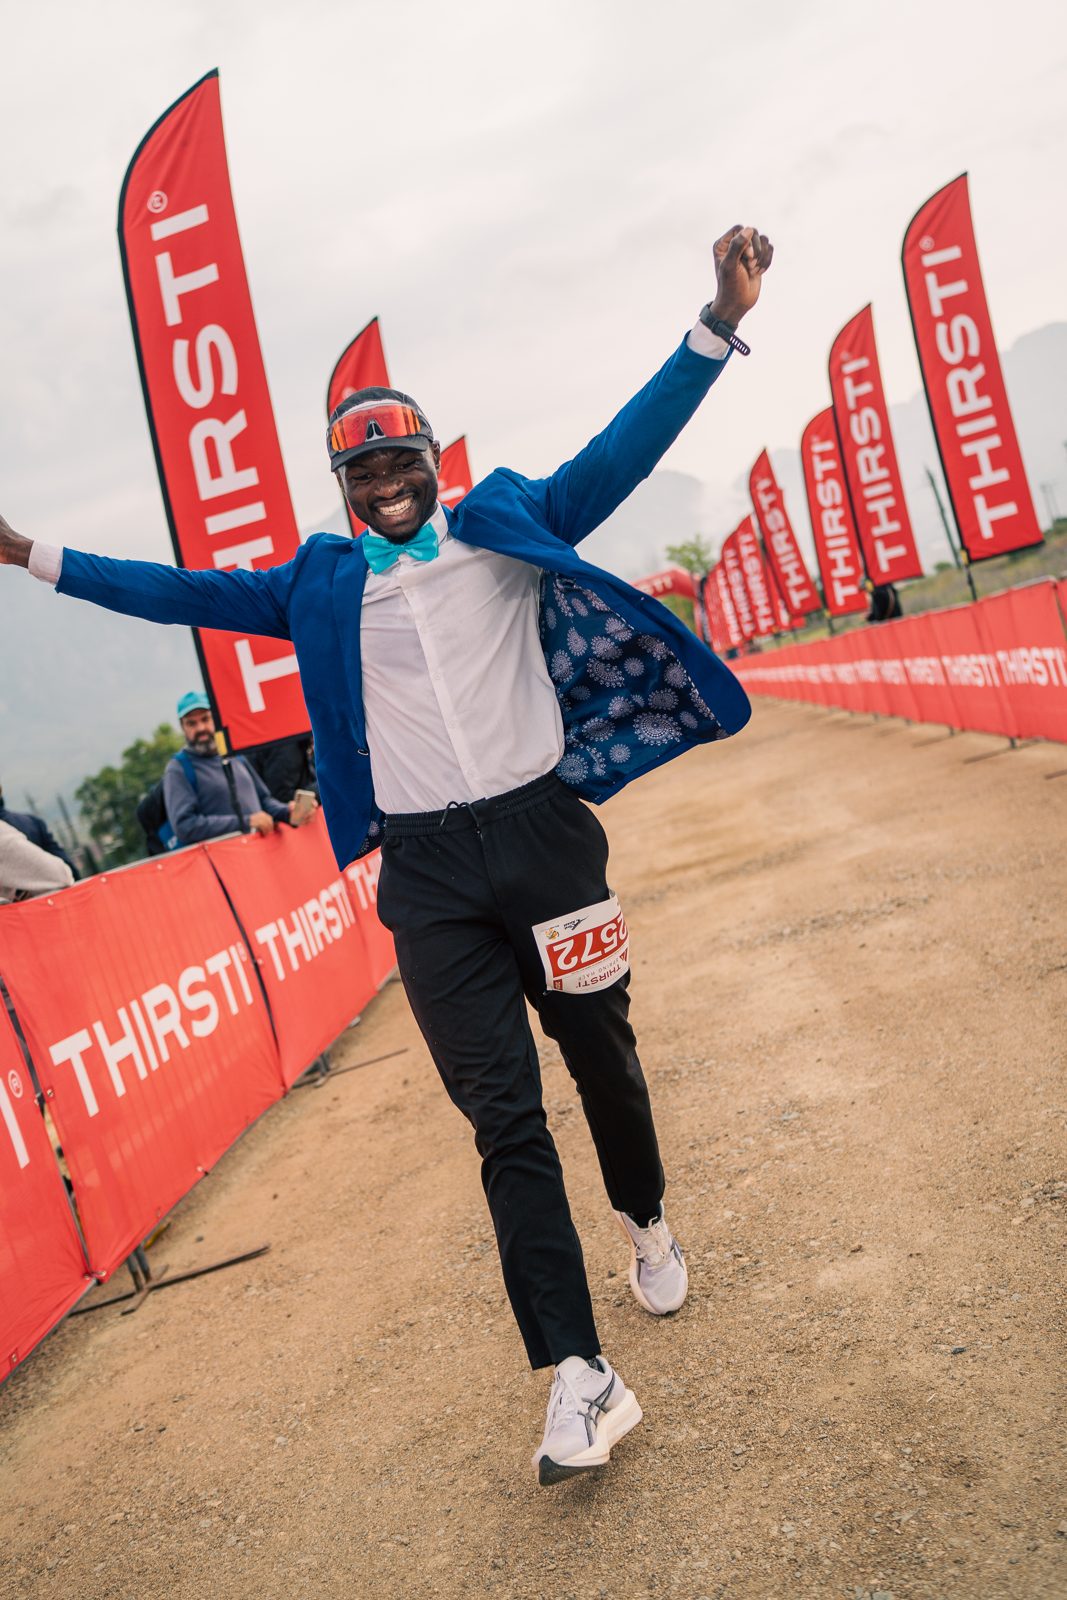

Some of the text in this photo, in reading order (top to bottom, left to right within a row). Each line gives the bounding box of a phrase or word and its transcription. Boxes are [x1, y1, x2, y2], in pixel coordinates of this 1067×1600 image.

[755, 477, 811, 610] THIRSTI
[996, 647, 1066, 687] THIRSTI
[255, 881, 354, 982] THIRSTI
[553, 917, 627, 971] 2572
[578, 965, 622, 988] THIRSTI
